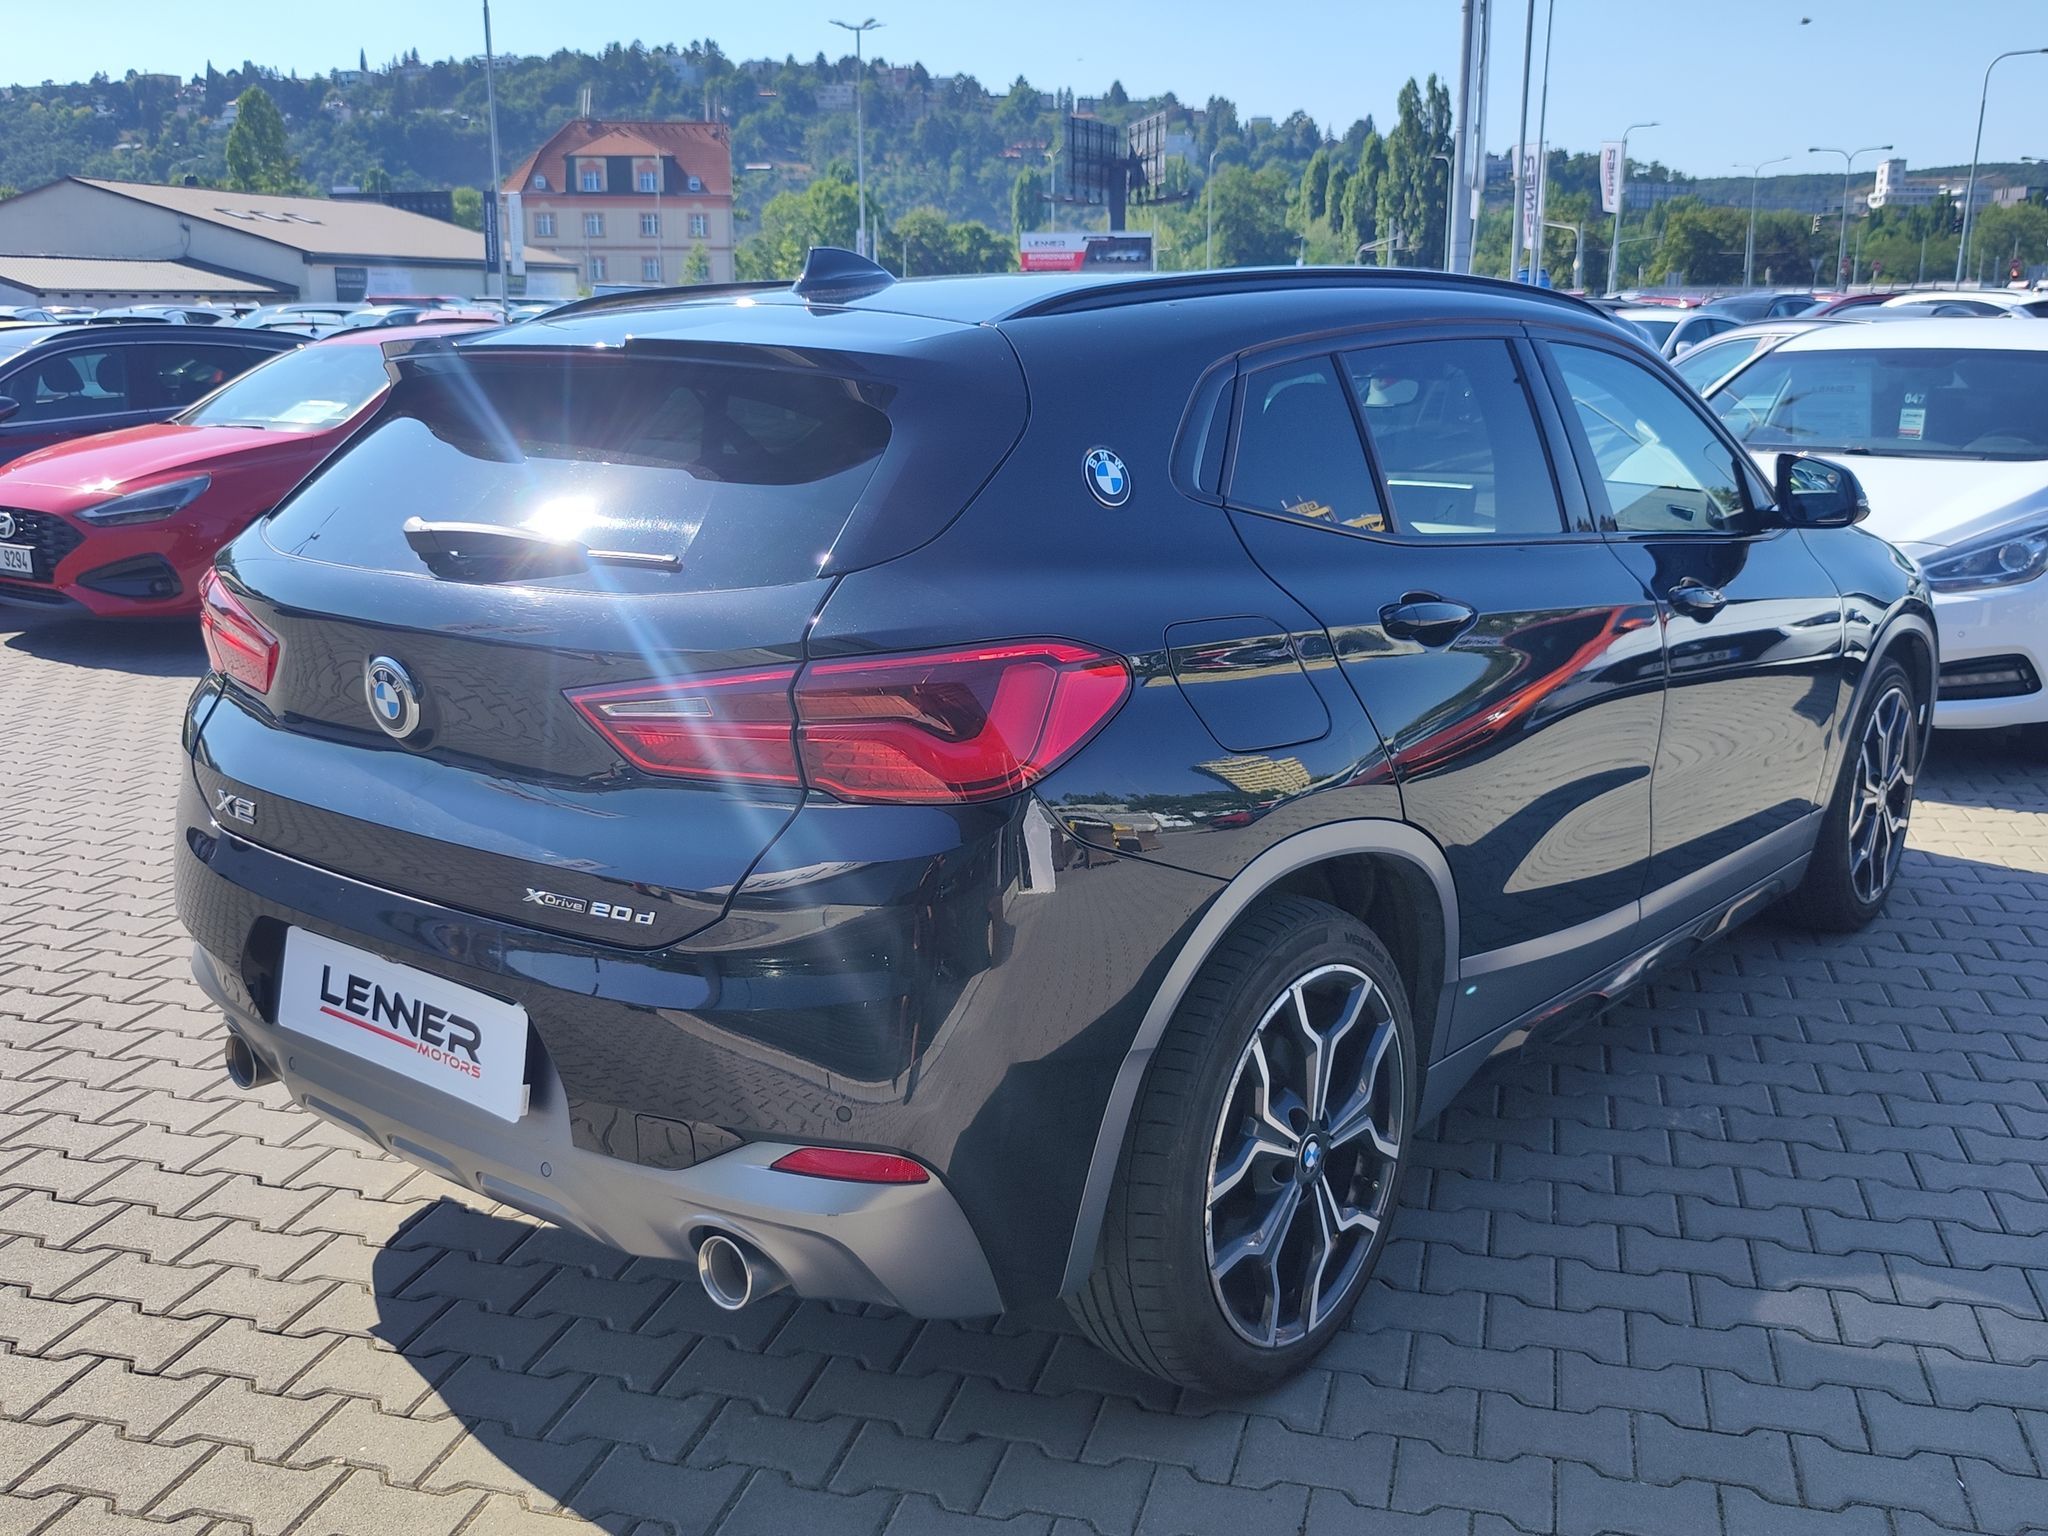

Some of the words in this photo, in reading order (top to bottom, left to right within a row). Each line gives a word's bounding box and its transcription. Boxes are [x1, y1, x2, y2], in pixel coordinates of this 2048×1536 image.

[4, 550, 28, 570] 9294
[215, 788, 257, 825] X2
[319, 964, 482, 1065] LENNER
[417, 1041, 482, 1079] MOTORS
